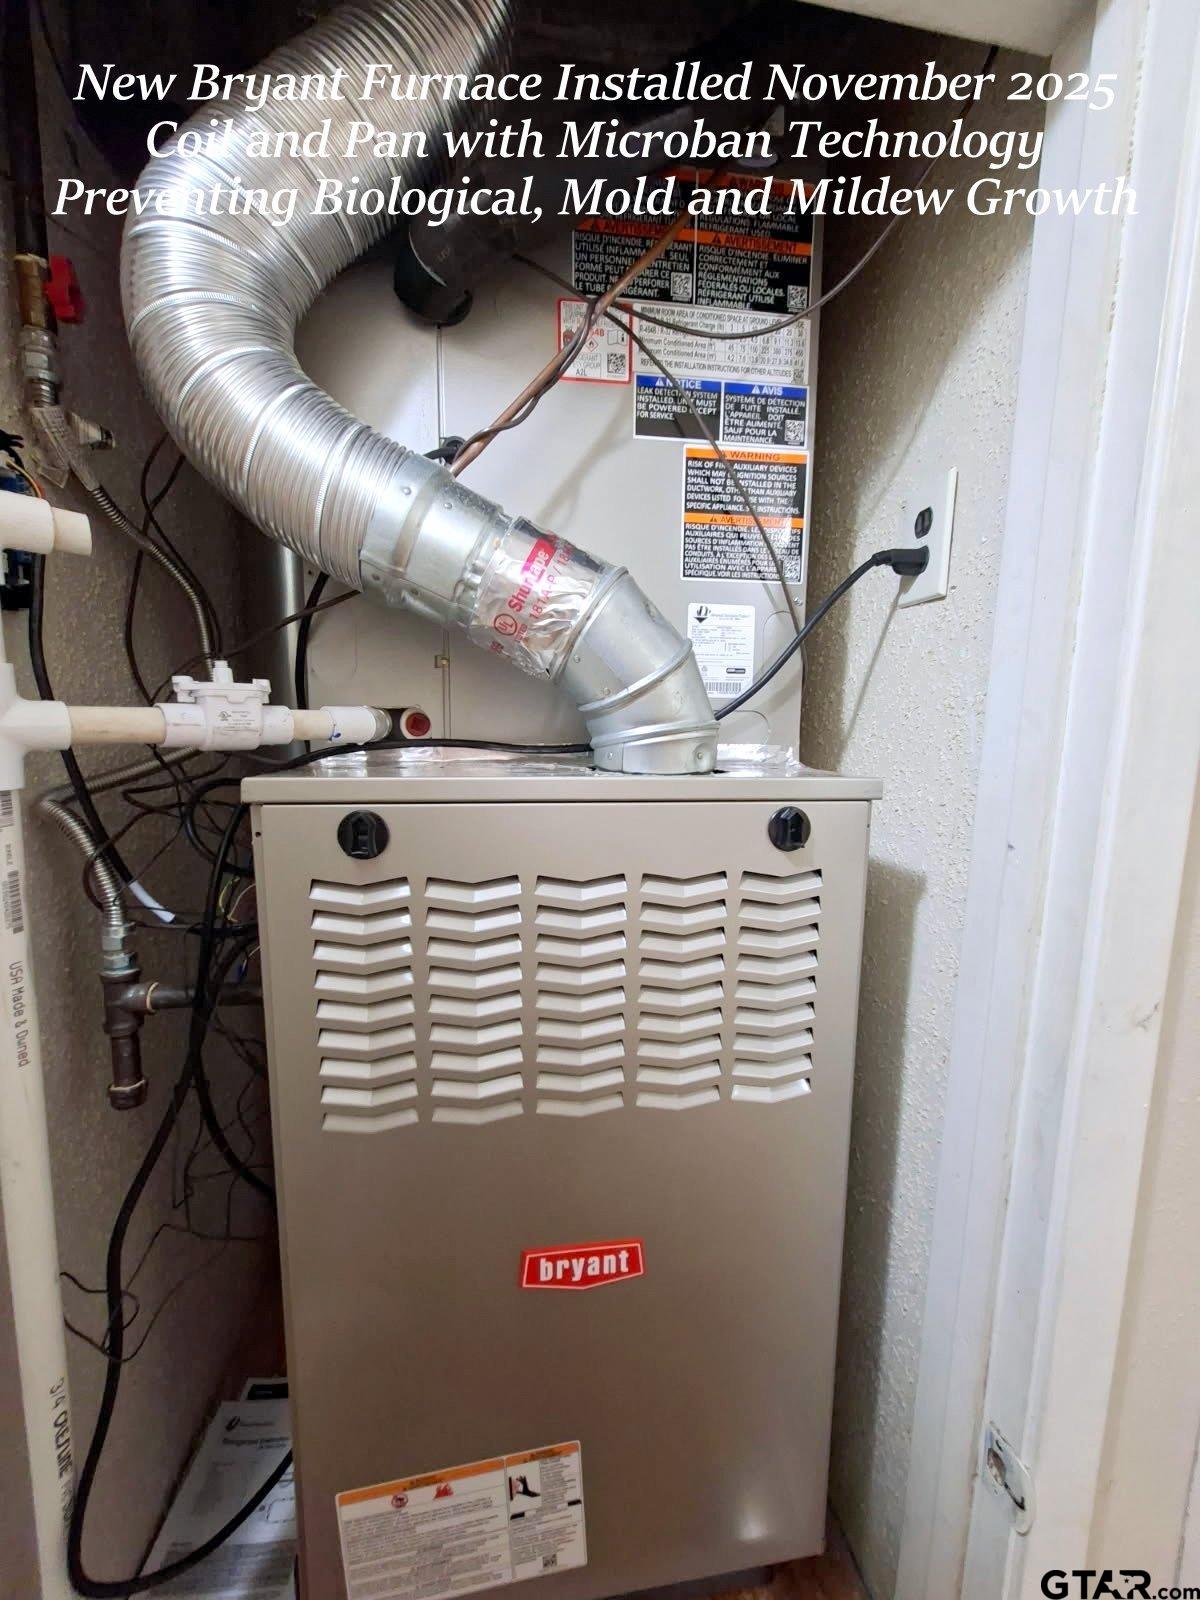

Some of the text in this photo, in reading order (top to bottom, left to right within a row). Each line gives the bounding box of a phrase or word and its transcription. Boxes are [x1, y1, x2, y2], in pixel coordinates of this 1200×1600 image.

[666, 376, 702, 390] NTICE
[761, 385, 784, 396] AVIS
[648, 403, 688, 414] POWERED
[677, 398, 695, 406] UNT
[695, 399, 717, 408] MUST
[723, 426, 778, 438] SAUF POUR LA
[730, 450, 781, 462] WARNING
[687, 460, 798, 474] RISK OF AUXILIARY DEVICES
[687, 468, 711, 477] WHICH
[711, 469, 726, 478] MAY
[767, 473, 797, 482] SOURCES
[686, 476, 709, 485] SHALL
[709, 477, 726, 486] NOT
[773, 481, 782, 490] IN
[782, 481, 797, 490] THE
[686, 493, 711, 501] DEVICES
[711, 493, 731, 502] LISTED
[747, 487, 765, 497] THAN
[686, 501, 712, 510] SPECIFIC
[685, 523, 710, 532] RISQUE
[684, 537, 712, 545] SOURCES
[684, 543, 697, 551] PAS
[684, 562, 745, 573] UTILISATION AVEC
[9, 960, 23, 985] USA
[12, 985, 25, 1018] Made
[539, 1249, 630, 1282] bryant
